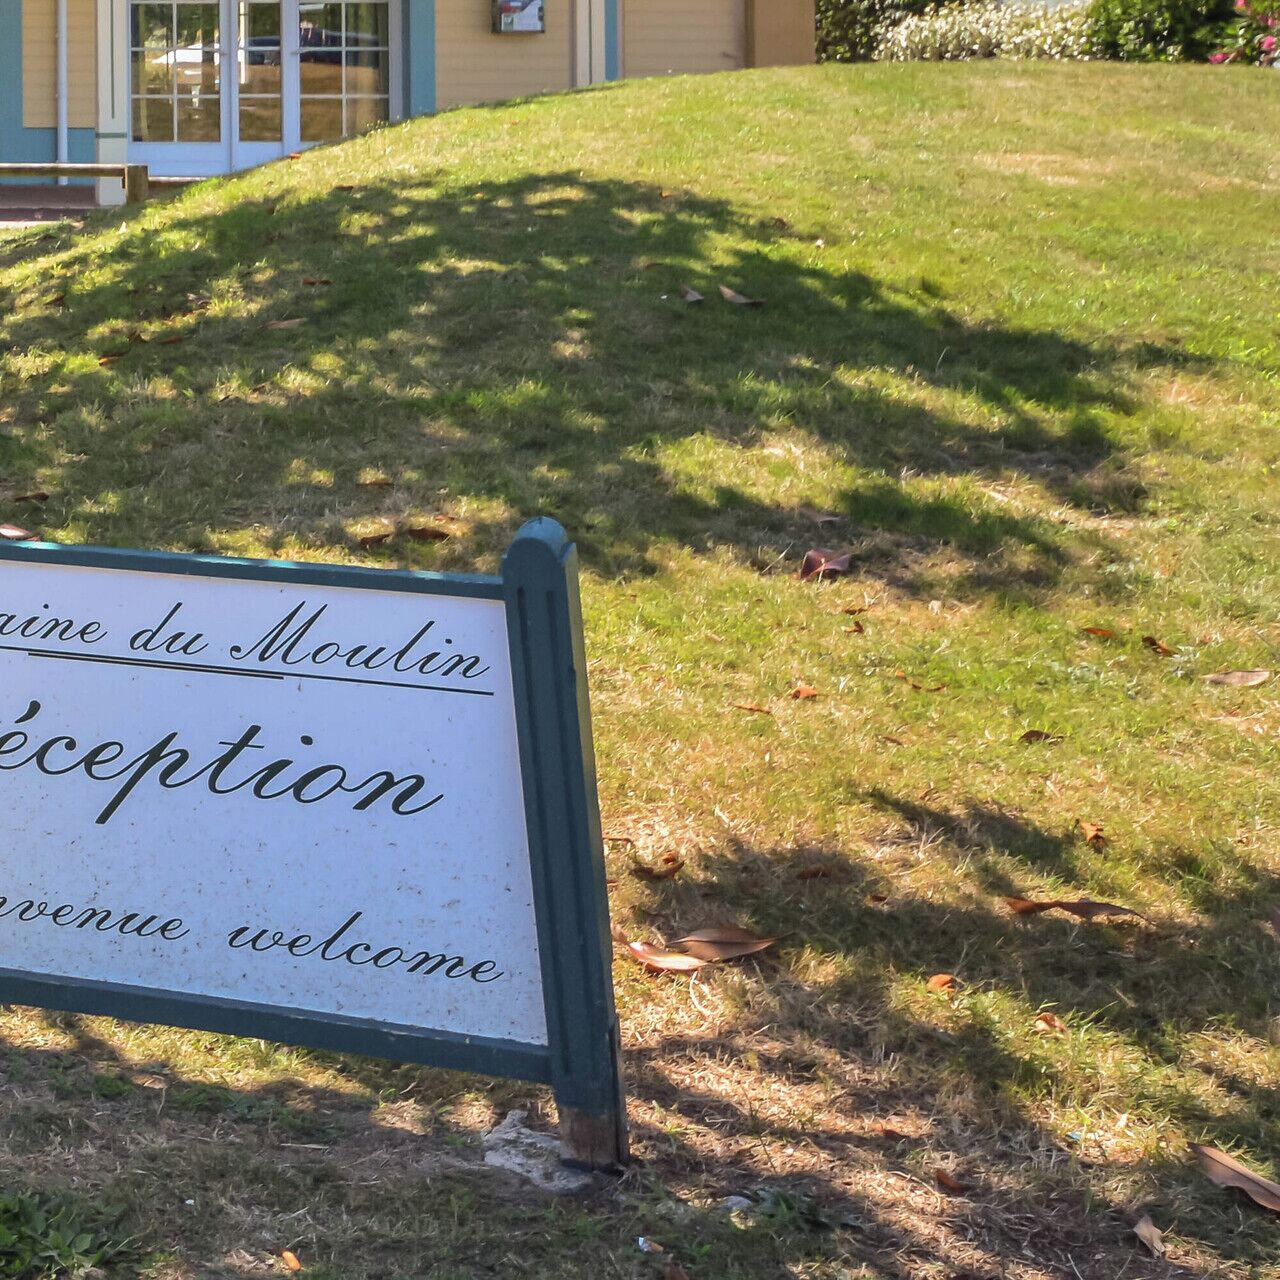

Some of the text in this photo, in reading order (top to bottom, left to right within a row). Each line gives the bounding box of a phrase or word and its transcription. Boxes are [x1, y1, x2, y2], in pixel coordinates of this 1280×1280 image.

[129, 602, 209, 656] du
[229, 600, 491, 680] Moulin
[228, 911, 505, 983] welcome
